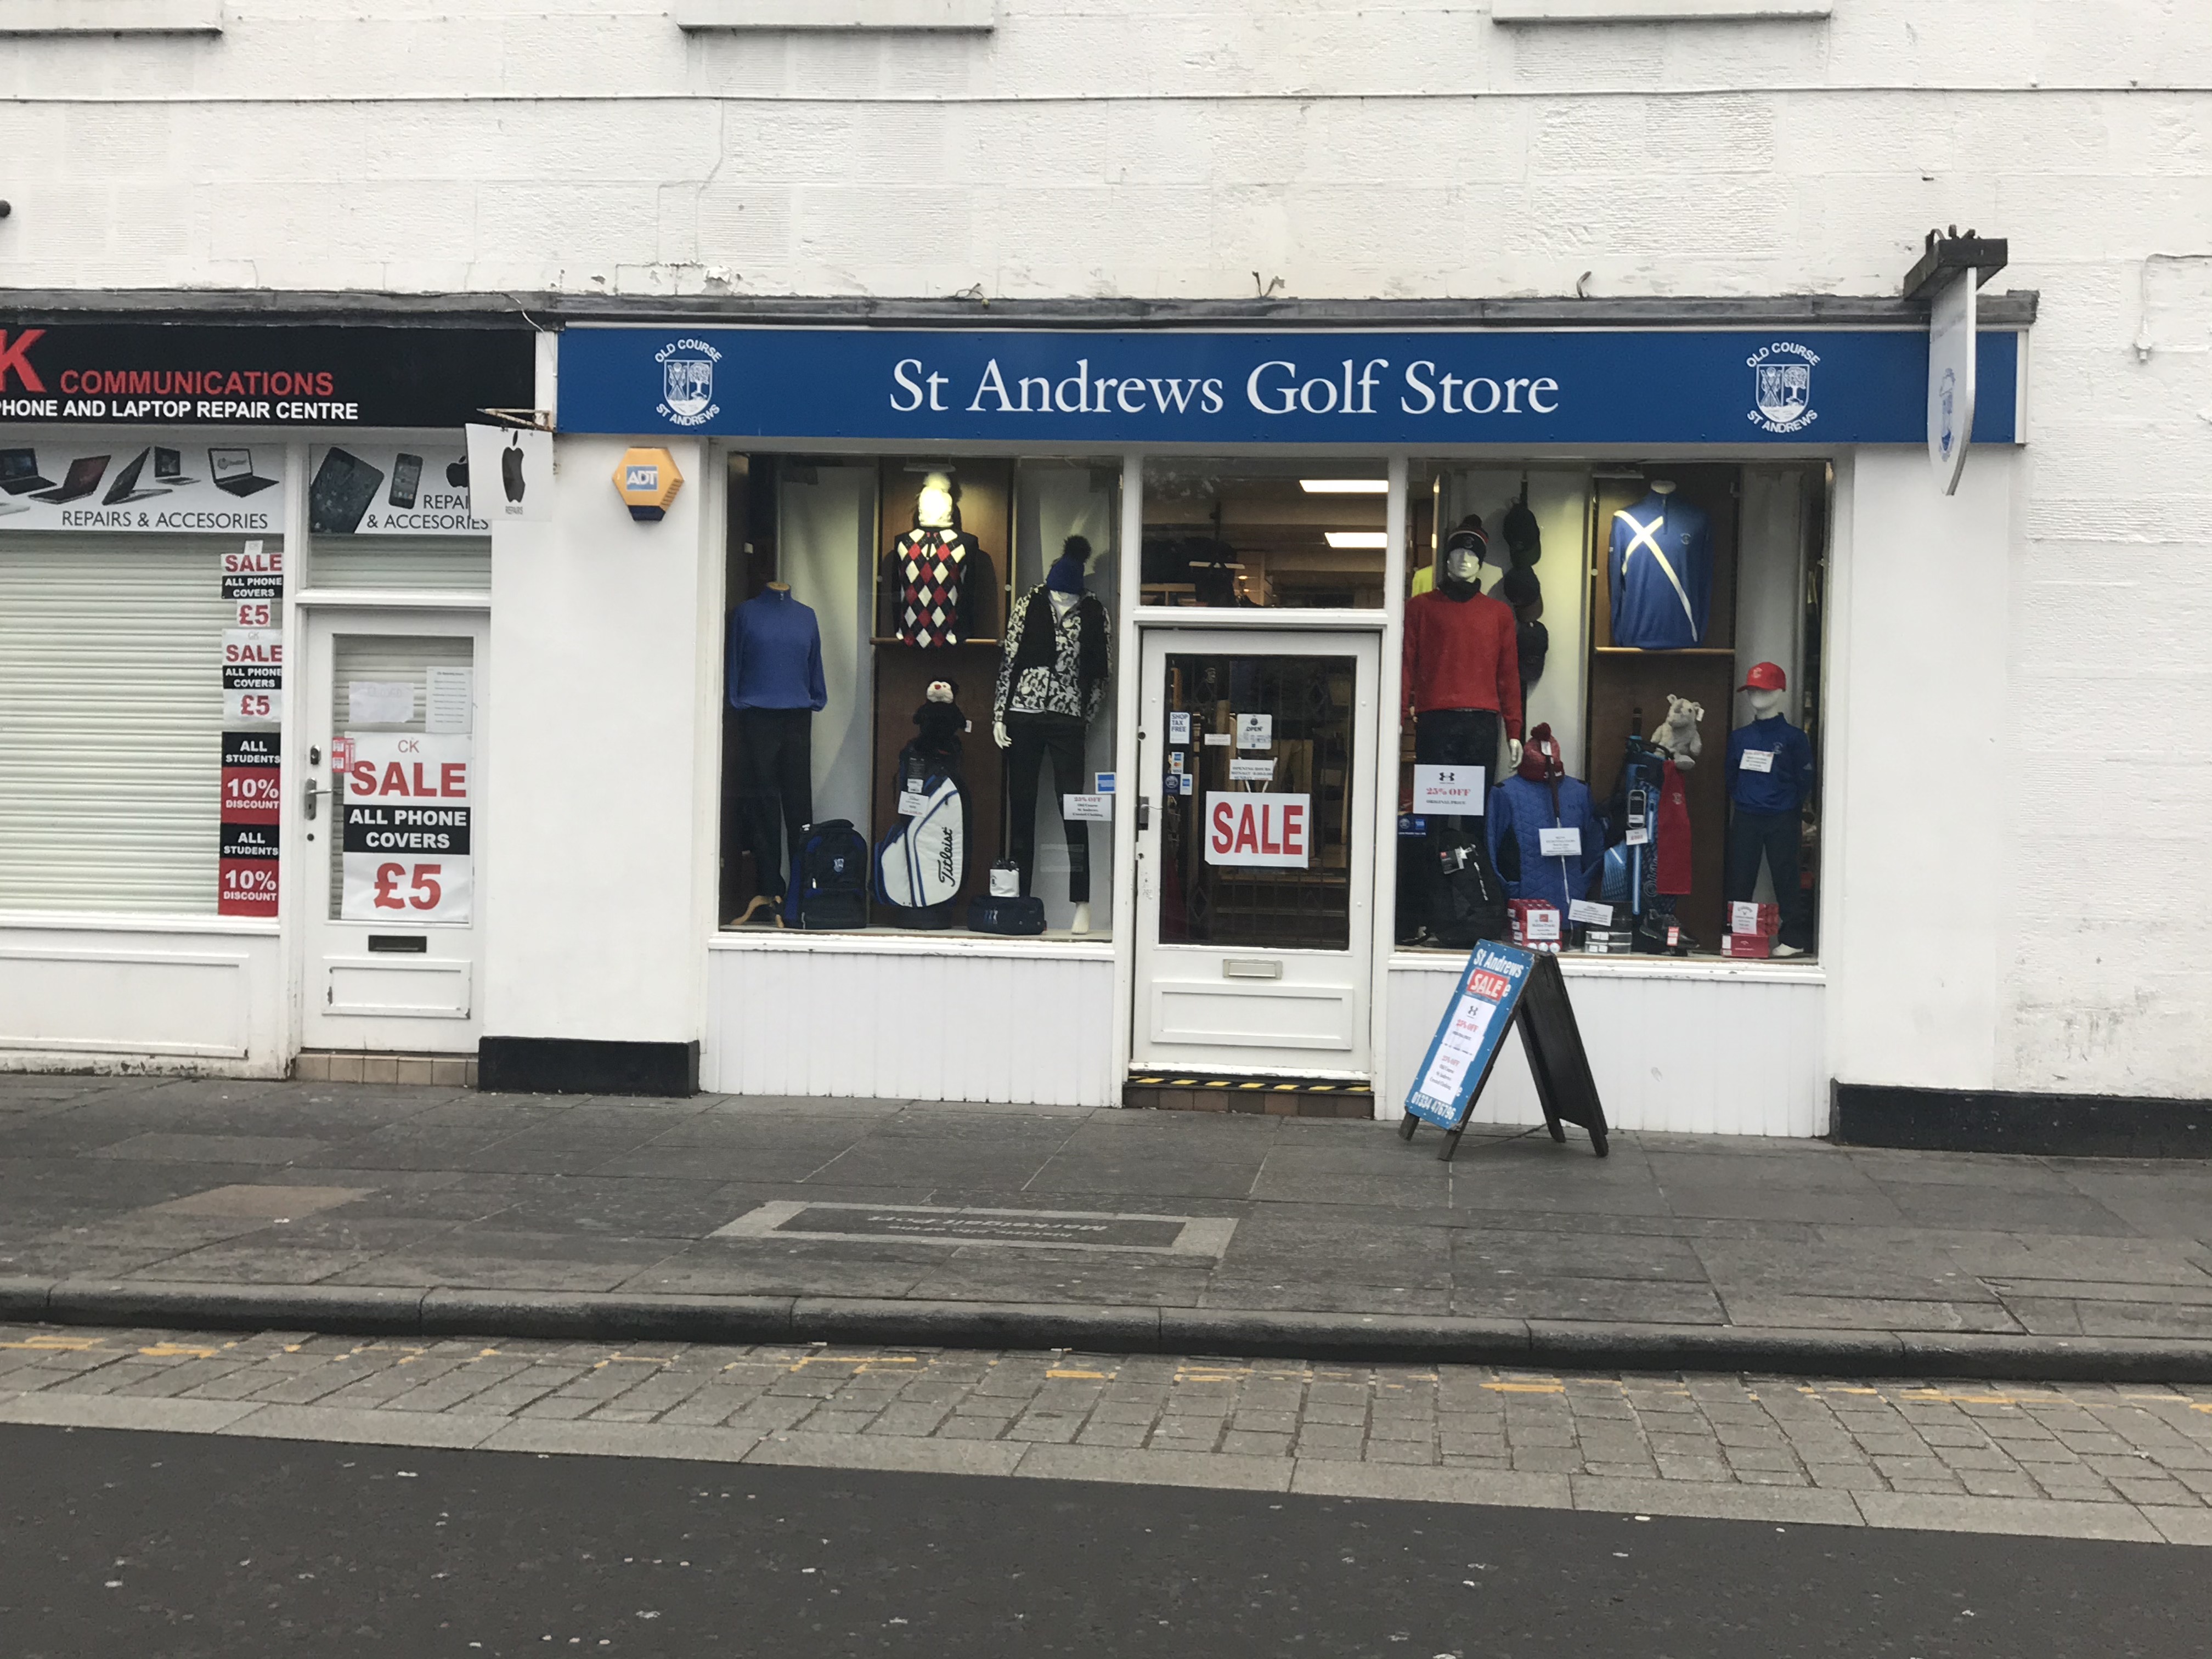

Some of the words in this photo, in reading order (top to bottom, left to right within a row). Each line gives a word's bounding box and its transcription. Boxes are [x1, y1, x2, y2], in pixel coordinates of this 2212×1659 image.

[655, 343, 676, 363] OLD
[677, 339, 723, 363] COURSE
[1746, 347, 1769, 367] OLD
[1771, 342, 1821, 366] COURSE
[0, 329, 47, 393] K
[60, 369, 334, 396] COMMUNICATIONS
[890, 358, 949, 411] St
[966, 358, 1224, 414] Andrews
[1246, 359, 1390, 414] Golf
[1401, 360, 1559, 414] Store
[0, 399, 58, 416] HONE
[63, 400, 106, 417] AND
[112, 400, 191, 417] LAPTOP
[197, 401, 270, 419] REPAIR
[276, 402, 358, 420] CENTRE
[656, 403, 671, 417] ST
[669, 404, 720, 426] ANDREWS
[1747, 410, 1763, 424] ST
[1761, 409, 1818, 433] ANDREWS
[627, 470, 658, 486] ADT
[423, 494, 469, 510] REPAI
[505, 506, 523, 515] REPAIRS
[62, 511, 132, 527] REPAIRS
[137, 512, 150, 527] &
[155, 512, 268, 529] ACCESORIES
[366, 514, 378, 528] &
[384, 514, 489, 530] ACCESORIES
[225, 554, 282, 572] SALE
[225, 578, 245, 586] ALL
[247, 577, 282, 586] PHONE
[233, 589, 275, 597] COVERS
[239, 604, 269, 625] £5
[226, 644, 282, 662] SALE
[225, 668, 245, 676] ALL
[247, 668, 281, 676] PHONE
[234, 679, 275, 687] COVERS
[241, 694, 270, 715] £5
[240, 741, 267, 752] ALL
[398, 740, 420, 753] CK
[225, 754, 281, 764] STUDENTS
[228, 777, 279, 798] 10%
[350, 760, 467, 798] SALE
[1426, 787, 1447, 795] 25%
[1449, 788, 1471, 797] OFF
[225, 799, 280, 809] DISCOUNT
[349, 808, 387, 825] ALL
[394, 810, 467, 826] PHONE
[1212, 802, 1304, 855] SALE
[238, 832, 266, 844] ALL
[365, 832, 451, 849] COVERS
[224, 845, 279, 856] STUDENTS
[937, 827, 956, 887] Titleist
[225, 870, 276, 890] 10%
[374, 862, 442, 911] £5
[223, 891, 277, 901] DISCOUNT
[1474, 949, 1487, 966] St
[1483, 952, 1525, 978] Andrews
[1470, 973, 1504, 998] SALE
[1410, 1091, 1433, 1110] 01334
[866, 1216, 938, 1224] Port
